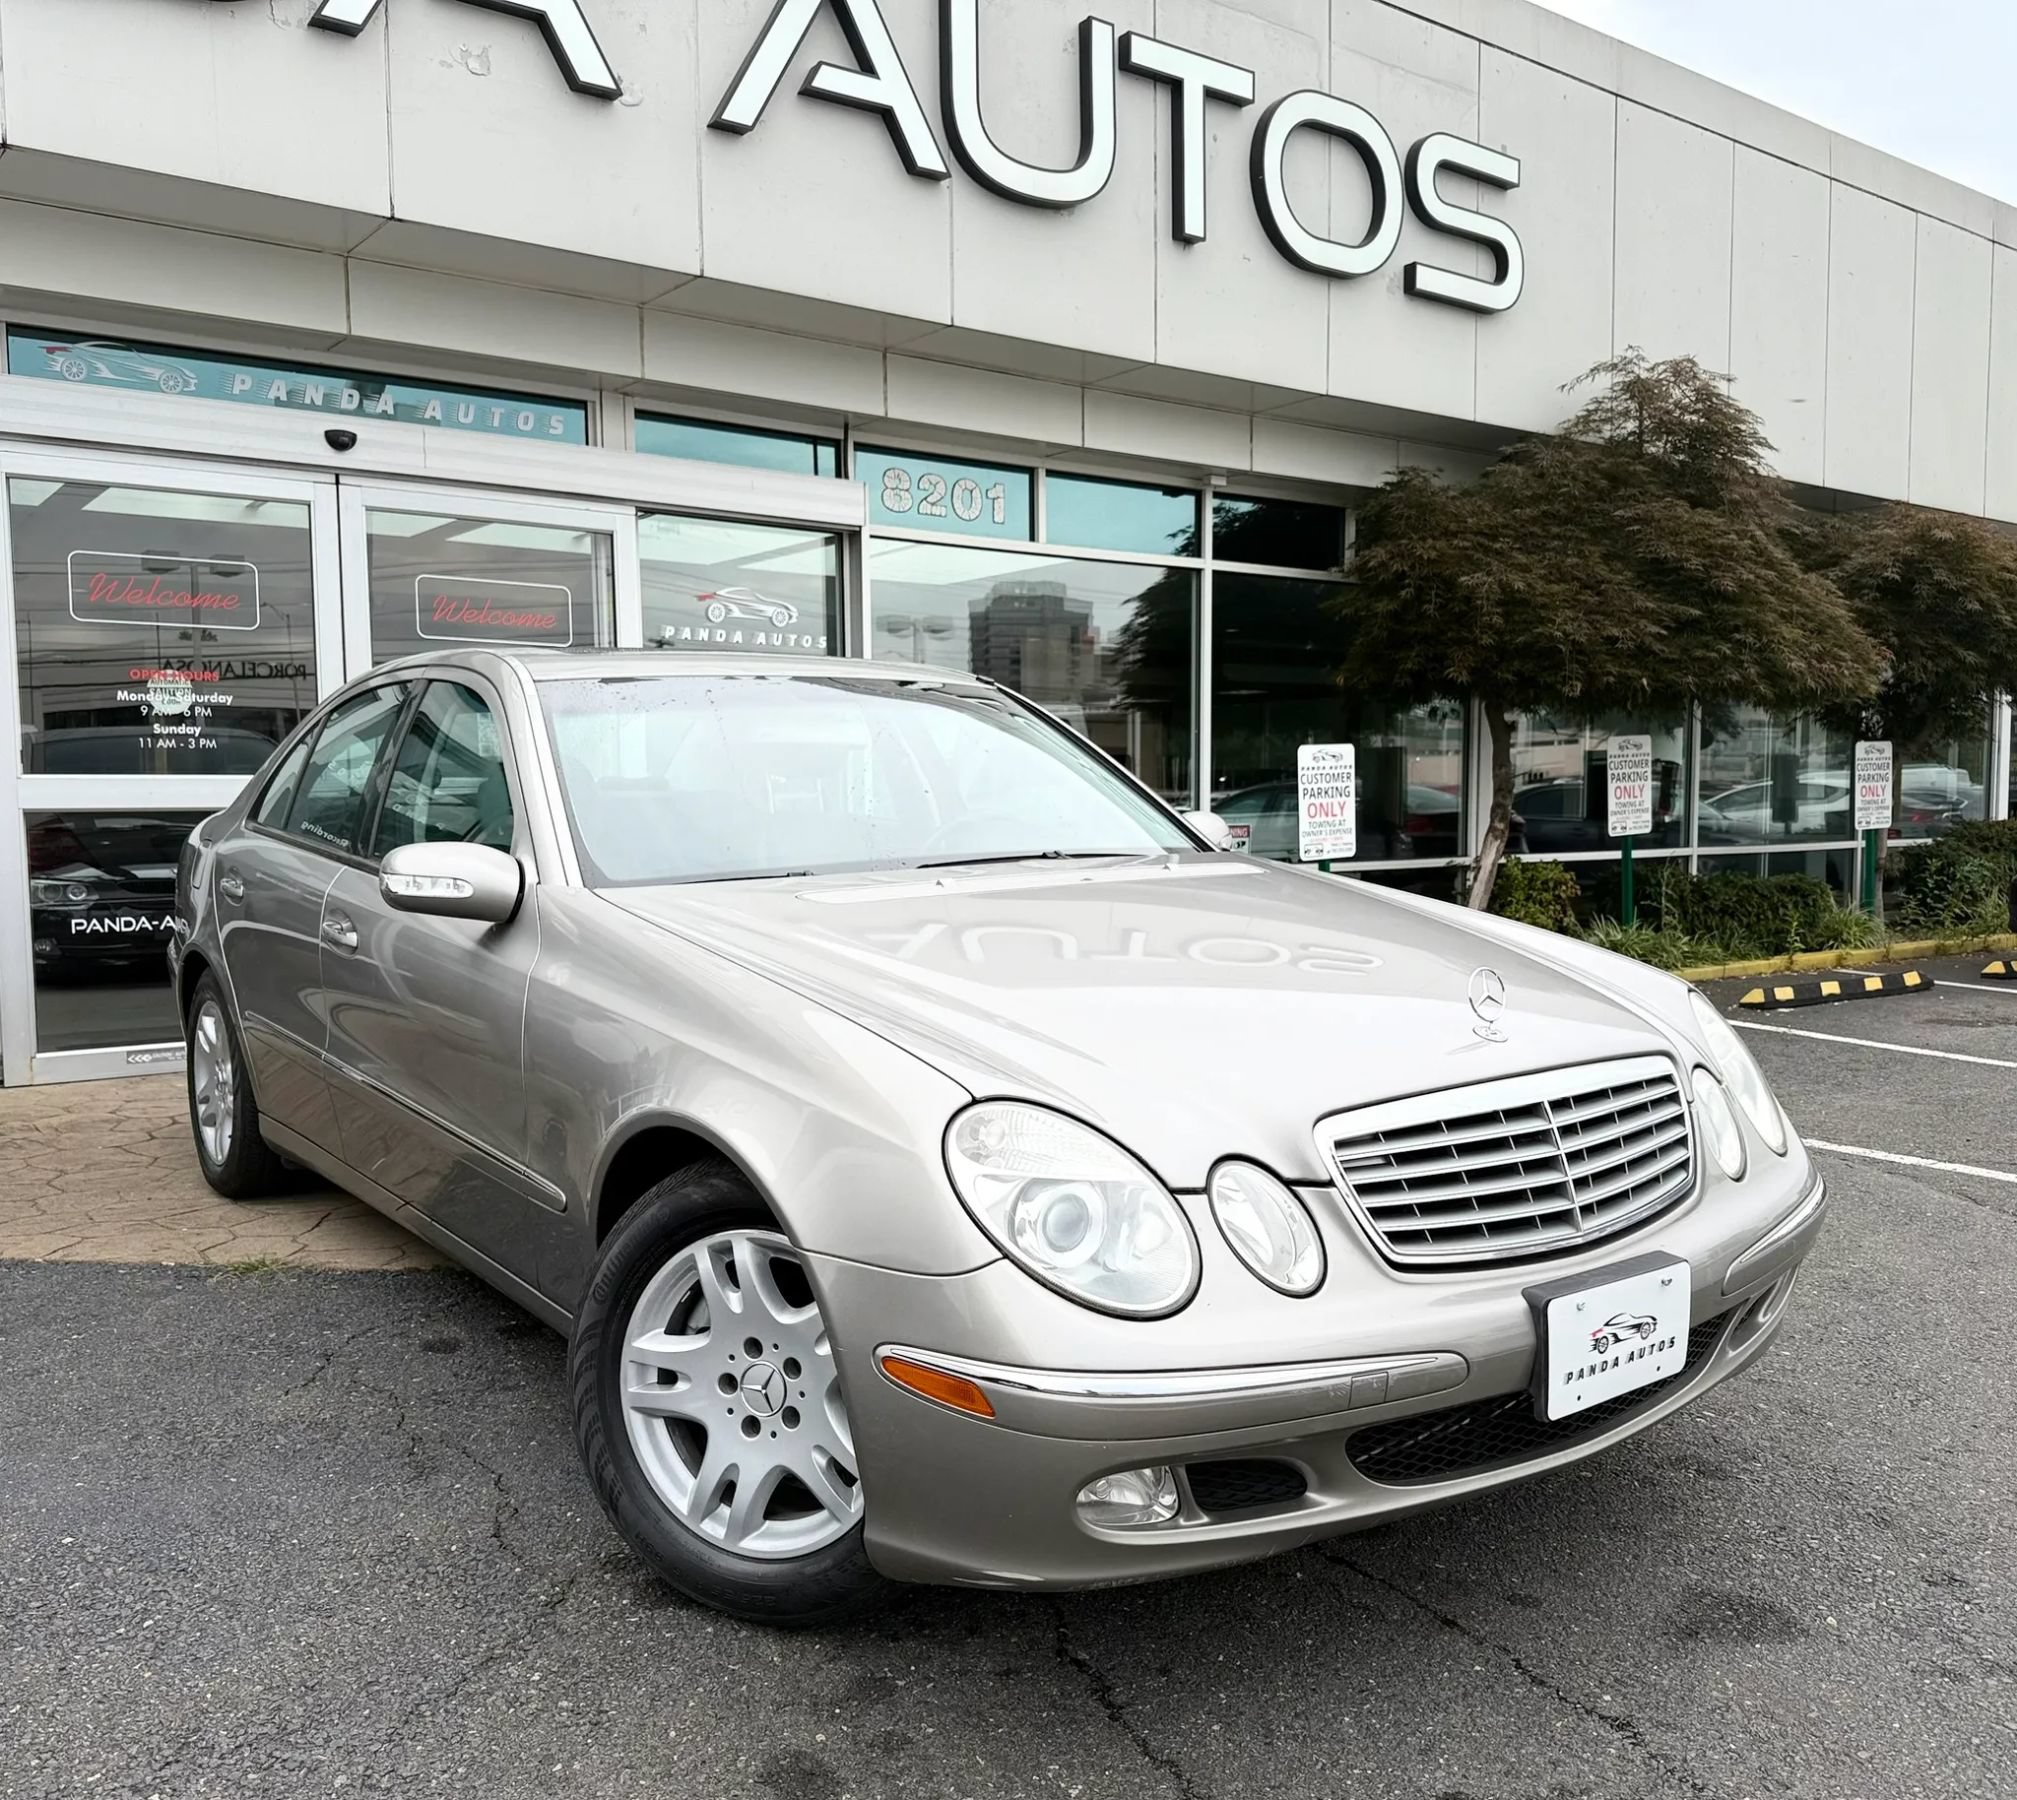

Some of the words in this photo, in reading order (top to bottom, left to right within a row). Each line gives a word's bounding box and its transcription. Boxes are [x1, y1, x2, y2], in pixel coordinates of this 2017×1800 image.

[707, 0, 1524, 314] AUTOS
[225, 372, 396, 416] PANDA
[423, 401, 566, 436] AUTOS
[881, 467, 1006, 525] 8201
[88, 571, 241, 611] Welcome
[431, 594, 557, 630] Welcome
[665, 625, 743, 646] PANDA
[755, 630, 828, 649] AUTOS
[128, 668, 168, 680] OPEN
[172, 670, 220, 682] HOURS
[140, 705, 149, 717] 9
[183, 705, 191, 717] 6
[194, 706, 213, 718] PM
[153, 723, 201, 737] Sunday
[139, 737, 152, 749] 11
[156, 738, 177, 749] AM
[188, 738, 196, 749] 3
[199, 738, 217, 749] PM
[1608, 759, 1650, 771] CUSTOMER
[1857, 763, 1890, 772] CUSTOMER
[1300, 772, 1352, 785] CUSTOMER
[1610, 772, 1649, 783] PARKING
[1857, 772, 1889, 783] PARKING
[1302, 785, 1351, 800] PARKING
[1614, 785, 1645, 800] ONLY
[1861, 785, 1886, 798] ONLY
[1307, 802, 1346, 819] ONLY
[1615, 801, 1637, 809] TOWING
[1638, 800, 1645, 808] AT
[1308, 820, 1337, 829] TOWING
[1338, 819, 1346, 828] AT
[1327, 827, 1352, 837] EXPENSE
[71, 915, 178, 935] PANDA-A
[1564, 1356, 1620, 1386] PANDA
[1626, 1336, 1676, 1364] AUTOS
